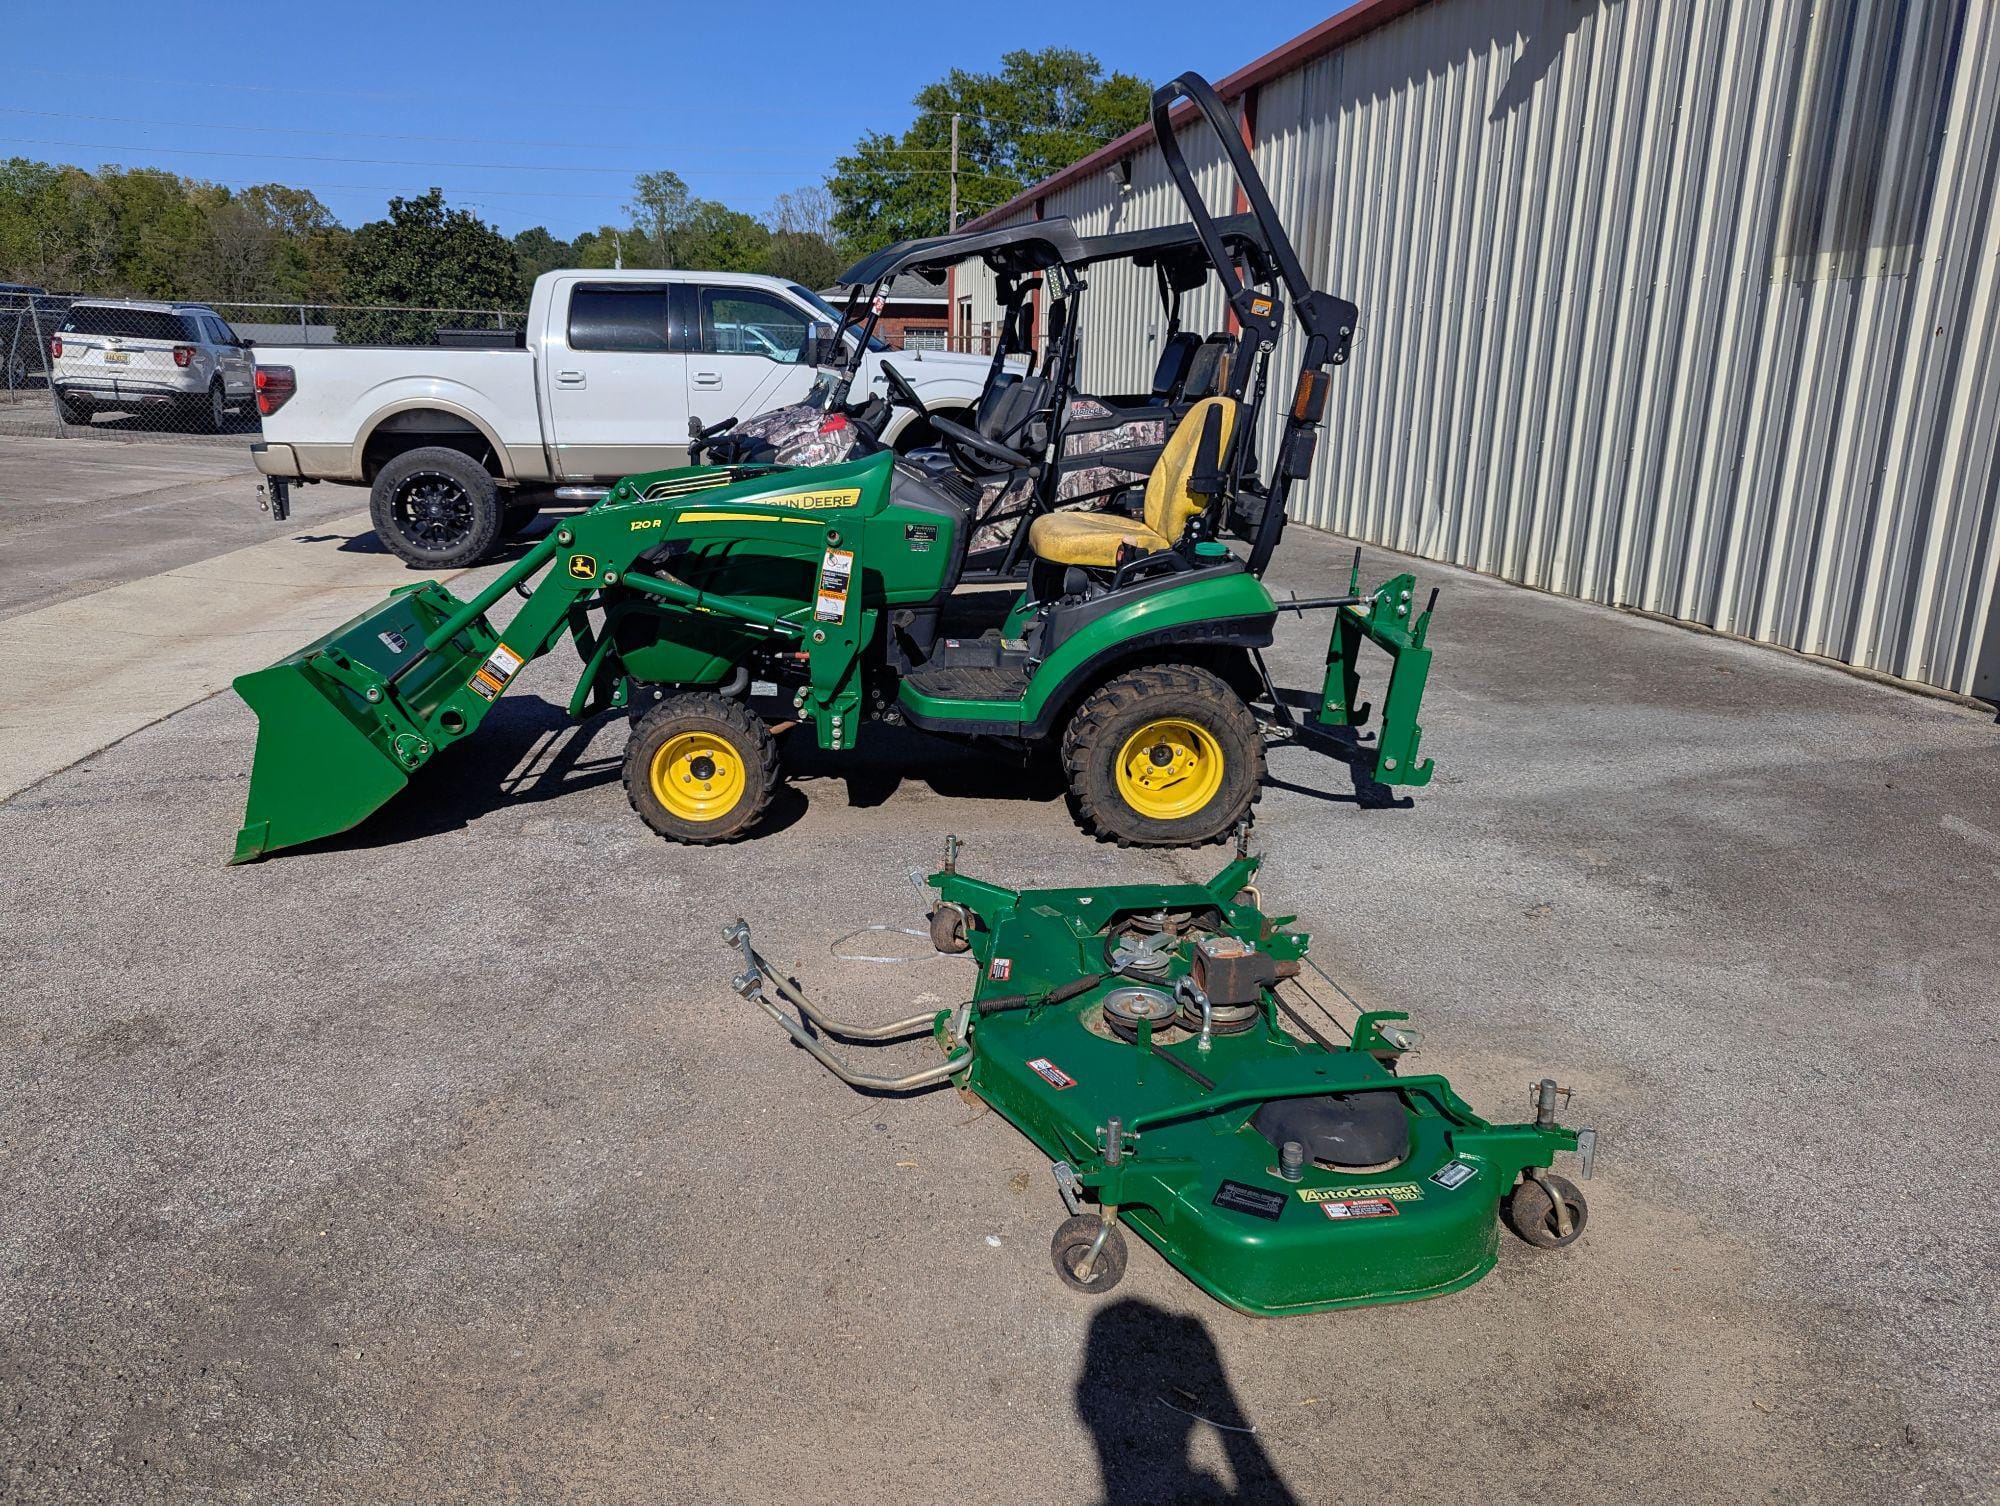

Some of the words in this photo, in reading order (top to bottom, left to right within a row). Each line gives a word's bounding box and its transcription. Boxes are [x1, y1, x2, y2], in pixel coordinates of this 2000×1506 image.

[803, 496, 852, 508] DEERE
[1305, 1184, 1420, 1201] AutoConnect
[1392, 1193, 1418, 1201] 60D
